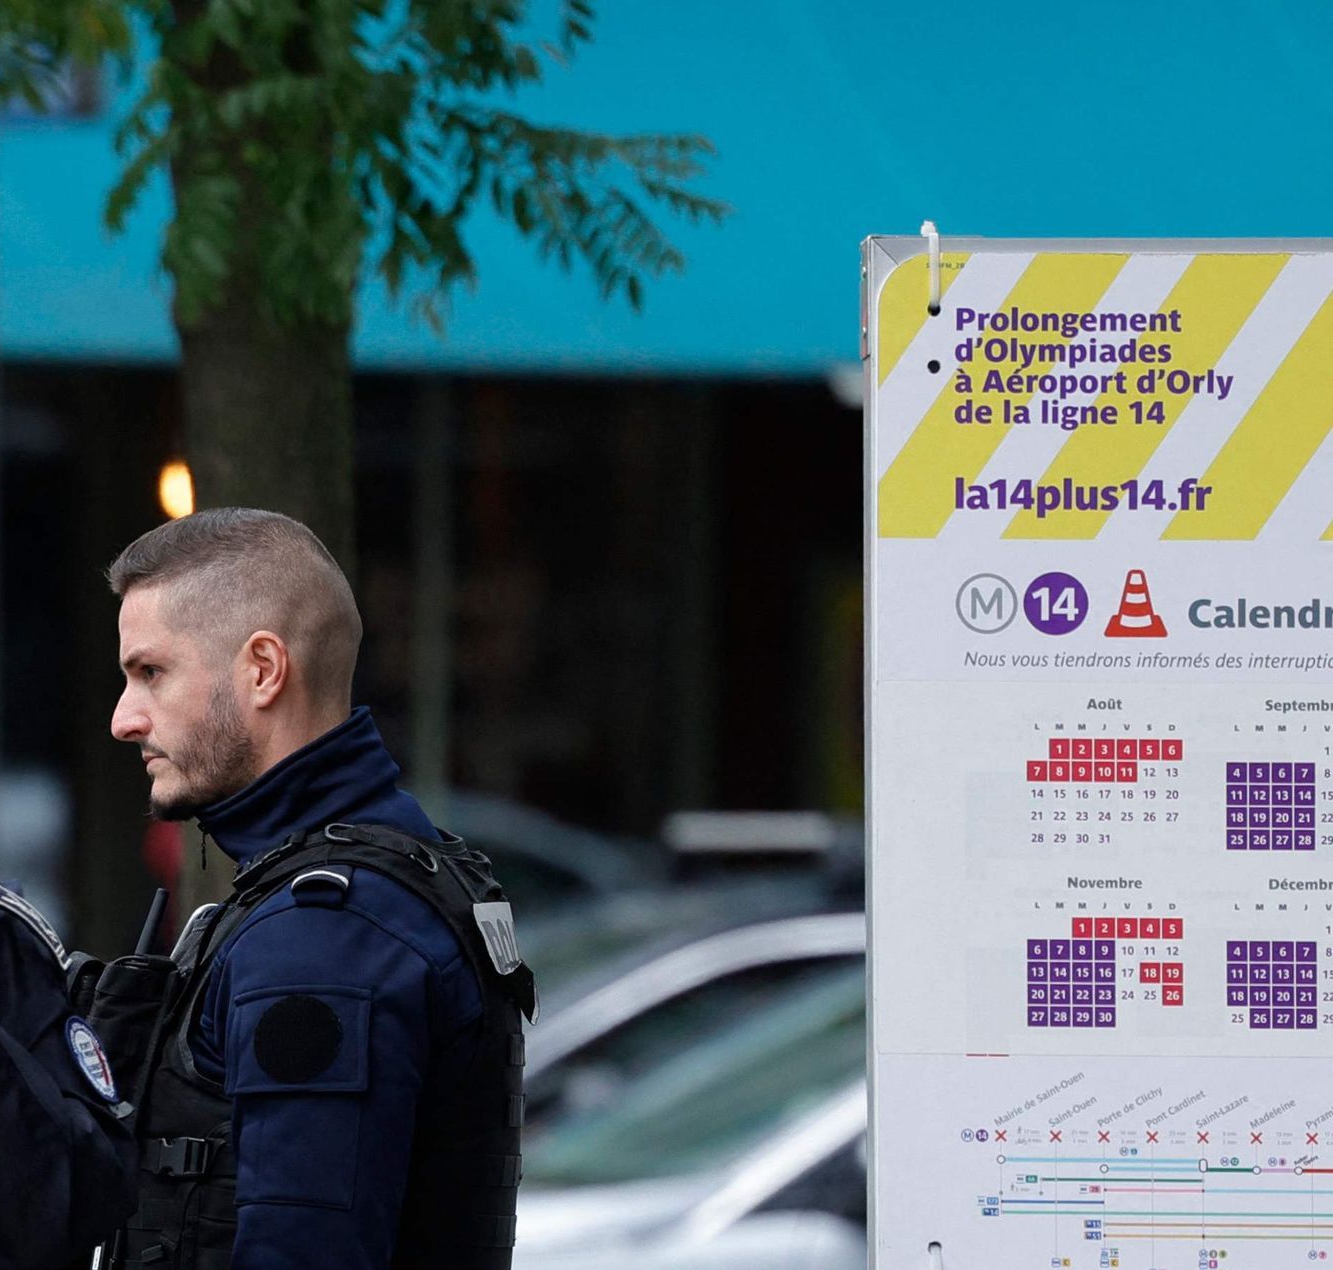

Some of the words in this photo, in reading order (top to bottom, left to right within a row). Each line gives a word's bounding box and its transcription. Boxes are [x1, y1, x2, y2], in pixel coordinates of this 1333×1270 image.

[956, 308, 1181, 337] Prolongement
[955, 338, 1171, 368] d'Olympiades
[956, 369, 972, 393] à
[983, 367, 1126, 400] Aéroport
[1137, 370, 1233, 400] d'Orly
[955, 401, 992, 424] de
[1003, 401, 1029, 424] la
[1041, 401, 1117, 430] ligne
[1129, 402, 1165, 424] 14
[955, 478, 1212, 518] la14plus14.fr
[1032, 588, 1078, 621] 14
[965, 652, 1005, 667] Nous
[1012, 655, 1048, 667] vous
[1055, 651, 1131, 668] tiendrons
[1136, 651, 1209, 669] informés
[1215, 653, 1242, 668] des
[1087, 699, 1122, 710] Août
[1056, 744, 1062, 755] 1
[1078, 744, 1086, 755] 2
[1101, 744, 1108, 755] 3
[1123, 744, 1131, 755] 4
[1146, 744, 1153, 756] 5
[1168, 744, 1176, 756] 6
[1033, 766, 1041, 777] 7
[1055, 766, 1064, 777] 8
[1078, 766, 1086, 777] 9
[1098, 766, 1112, 777] 10
[1120, 767, 1133, 777] 11
[1143, 767, 1157, 778] 12
[1165, 767, 1179, 778] 13
[1031, 788, 1044, 798] 14
[1053, 789, 1067, 799] 15
[1076, 789, 1089, 800] 16
[1098, 789, 1112, 799] 17
[1120, 789, 1134, 800] 18
[1143, 789, 1157, 800] 19
[1165, 789, 1179, 800] 20
[1031, 810, 1043, 821] 21
[1053, 811, 1067, 821] 22
[1075, 811, 1089, 822] 23
[1098, 811, 1112, 822] 24
[1120, 811, 1134, 822] 25
[1143, 811, 1157, 822] 26
[1165, 812, 1179, 822] 27
[1031, 833, 1044, 843] 28
[1053, 833, 1067, 844] 29
[1076, 833, 1090, 844] 30
[1098, 833, 1111, 844] 31
[1068, 877, 1142, 888] Novembre
[1079, 923, 1085, 933] 1
[1101, 922, 1109, 934] 2
[1124, 923, 1131, 934] 3
[1146, 923, 1154, 934] 4
[1169, 923, 1176, 934] 5
[1033, 944, 1042, 955] 6
[1056, 944, 1064, 955] 7
[1078, 945, 1086, 956] 8
[1101, 945, 1109, 956] 9
[1121, 945, 1135, 956] 10
[1143, 946, 1156, 956] 11
[1166, 946, 1179, 956] 12
[1031, 966, 1044, 978] 13
[1053, 967, 1067, 977] 14
[1076, 967, 1089, 978] 15
[1098, 967, 1113, 978] 16
[1121, 968, 1135, 978] 17
[1143, 968, 1157, 978] 18
[1166, 968, 1180, 979] 19
[1031, 989, 1045, 1000] 20
[1053, 989, 1066, 1000] 21
[1076, 989, 1090, 1000] 22
[1098, 989, 1112, 1000] 23
[1121, 990, 1135, 1001] 24
[1143, 990, 1157, 1001] 25
[1166, 990, 1180, 1001] 26
[994, 1107, 1023, 1127] Mairie
[1024, 1099, 1036, 1110] de
[1036, 1071, 1085, 1103] Saint-Ouen
[1097, 1111, 1122, 1128] Porte
[1123, 1103, 1134, 1114] de
[1135, 1087, 1163, 1106] Clichy
[1145, 1111, 1167, 1128] Pont
[1168, 1090, 1206, 1115] Cardinet
[1048, 1096, 1097, 1128] Saint-Ouen
[1196, 1095, 1249, 1129] Saint-Lazare
[1250, 1099, 1296, 1129] Madeleine
